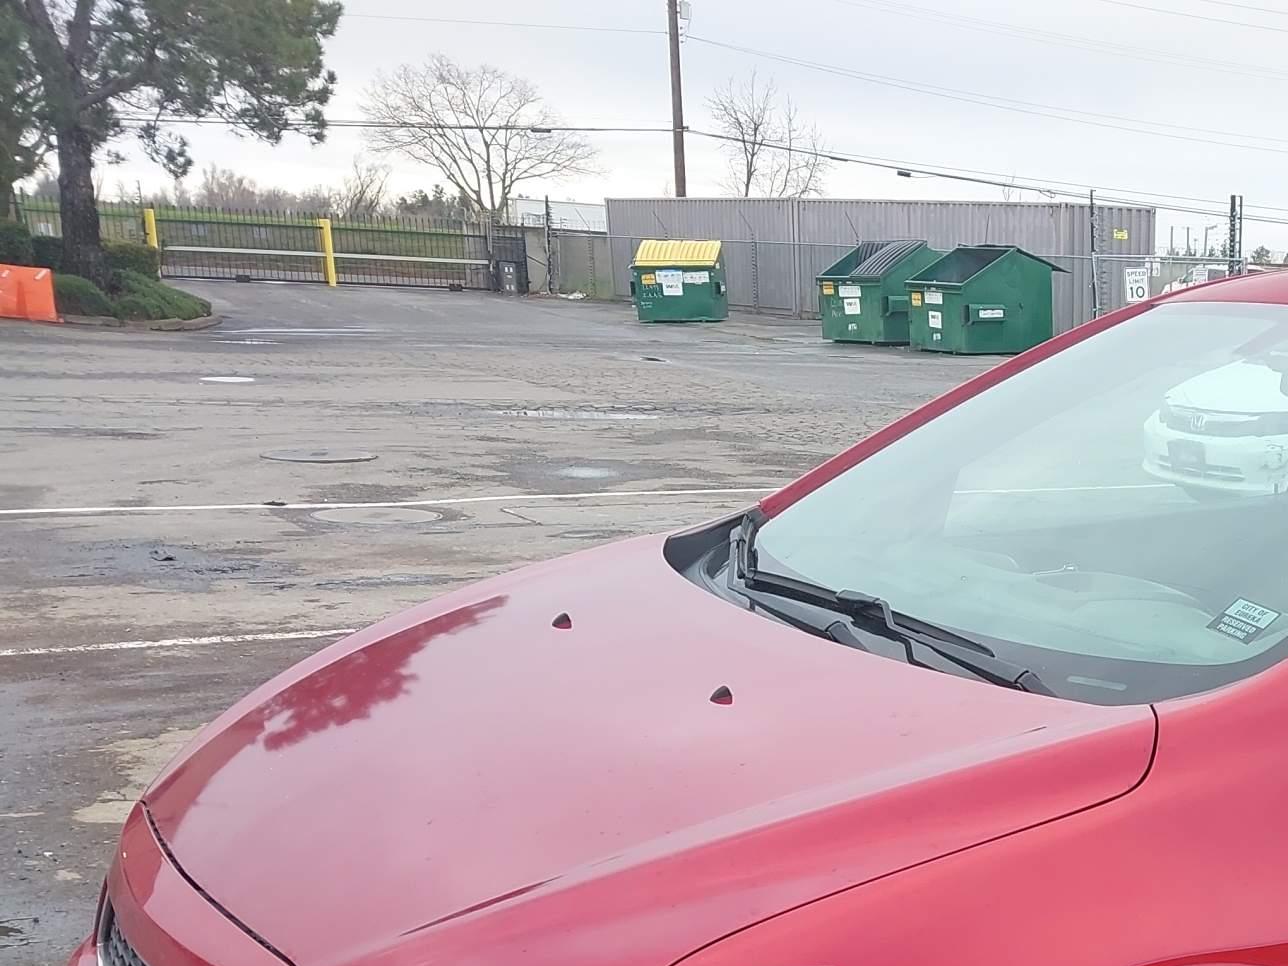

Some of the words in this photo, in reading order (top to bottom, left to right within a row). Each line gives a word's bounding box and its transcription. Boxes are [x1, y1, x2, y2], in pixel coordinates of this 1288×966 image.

[1130, 286, 1145, 298] 10
[1234, 610, 1262, 623] EUREKA
[1241, 604, 1257, 614] CITY
[1258, 609, 1270, 617] OF
[1222, 615, 1257, 634] RESERVED
[1216, 623, 1248, 640] PARKING
